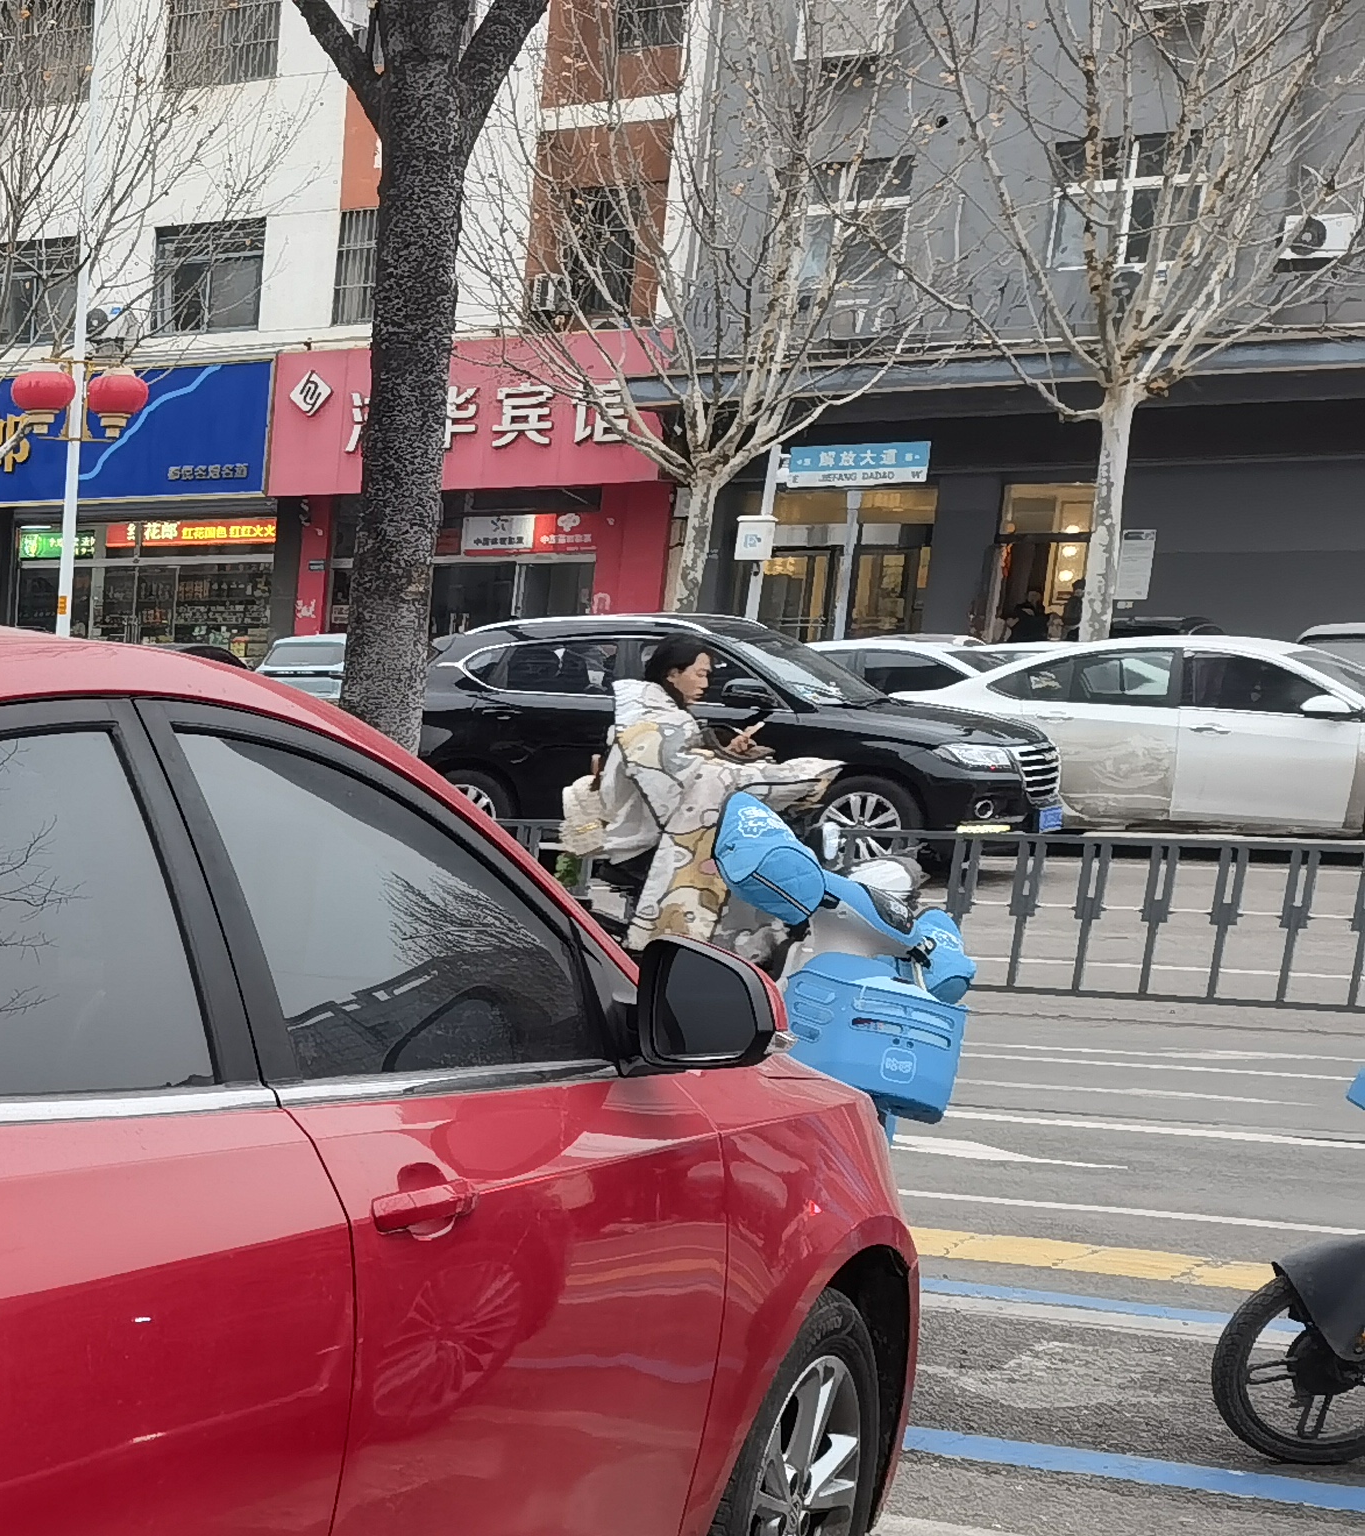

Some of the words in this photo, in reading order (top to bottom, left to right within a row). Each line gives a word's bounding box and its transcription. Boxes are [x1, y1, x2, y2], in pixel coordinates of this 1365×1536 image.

[345, 379, 628, 453] 华宾馆
[818, 448, 898, 467] 解放大道
